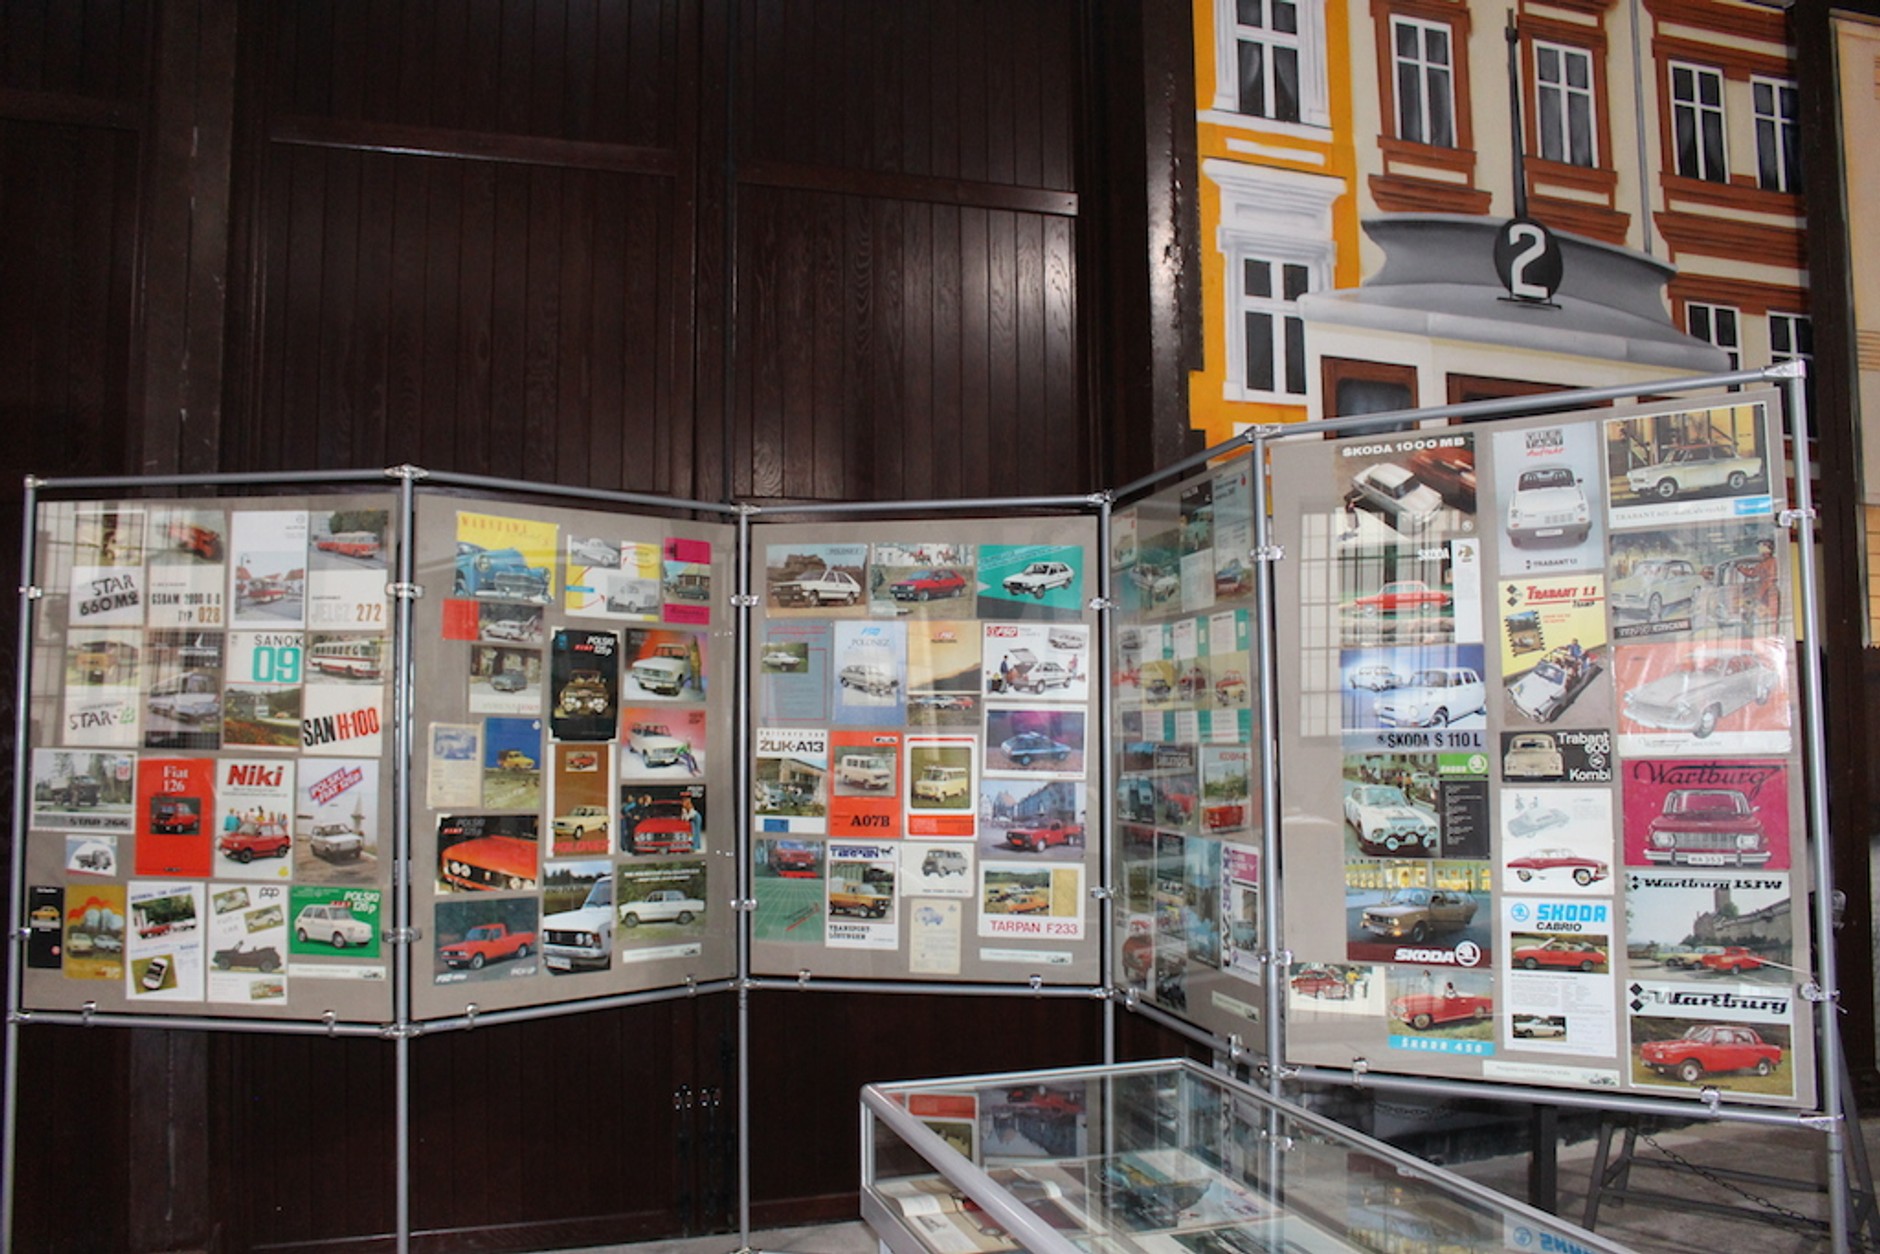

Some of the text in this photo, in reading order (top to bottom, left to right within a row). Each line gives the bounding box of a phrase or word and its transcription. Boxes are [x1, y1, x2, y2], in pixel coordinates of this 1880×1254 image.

[1508, 222, 1547, 298] 2
[1396, 440, 1437, 452] 1000
[1440, 437, 1465, 447] MB
[91, 574, 134, 597] STAR
[1526, 586, 1578, 599] TRABANT
[356, 603, 382, 622] 272
[254, 634, 304, 648] SANOK
[252, 646, 300, 683] 09
[302, 706, 380, 747] SAN H-100
[1435, 733, 1443, 747] S
[1448, 733, 1470, 747] 110
[1474, 734, 1482, 747] L
[1557, 732, 1609, 745] Trabant
[1584, 744, 1609, 754] 600
[163, 765, 189, 779] Fiat
[227, 764, 284, 787] Niki
[1569, 768, 1612, 781] Kombi
[163, 779, 185, 793] 126
[1633, 760, 1782, 801] Wartburg
[850, 815, 890, 827] A07B
[1643, 877, 1783, 890] Wartburg 353W
[344, 891, 380, 902] POLSKI
[352, 901, 376, 914] 126p
[1536, 903, 1607, 922] SKODA
[990, 920, 1041, 933] TARPAN
[1536, 922, 1583, 931] CABRIO
[1394, 947, 1456, 963] SKODA
[1454, 1043, 1483, 1054] 450
